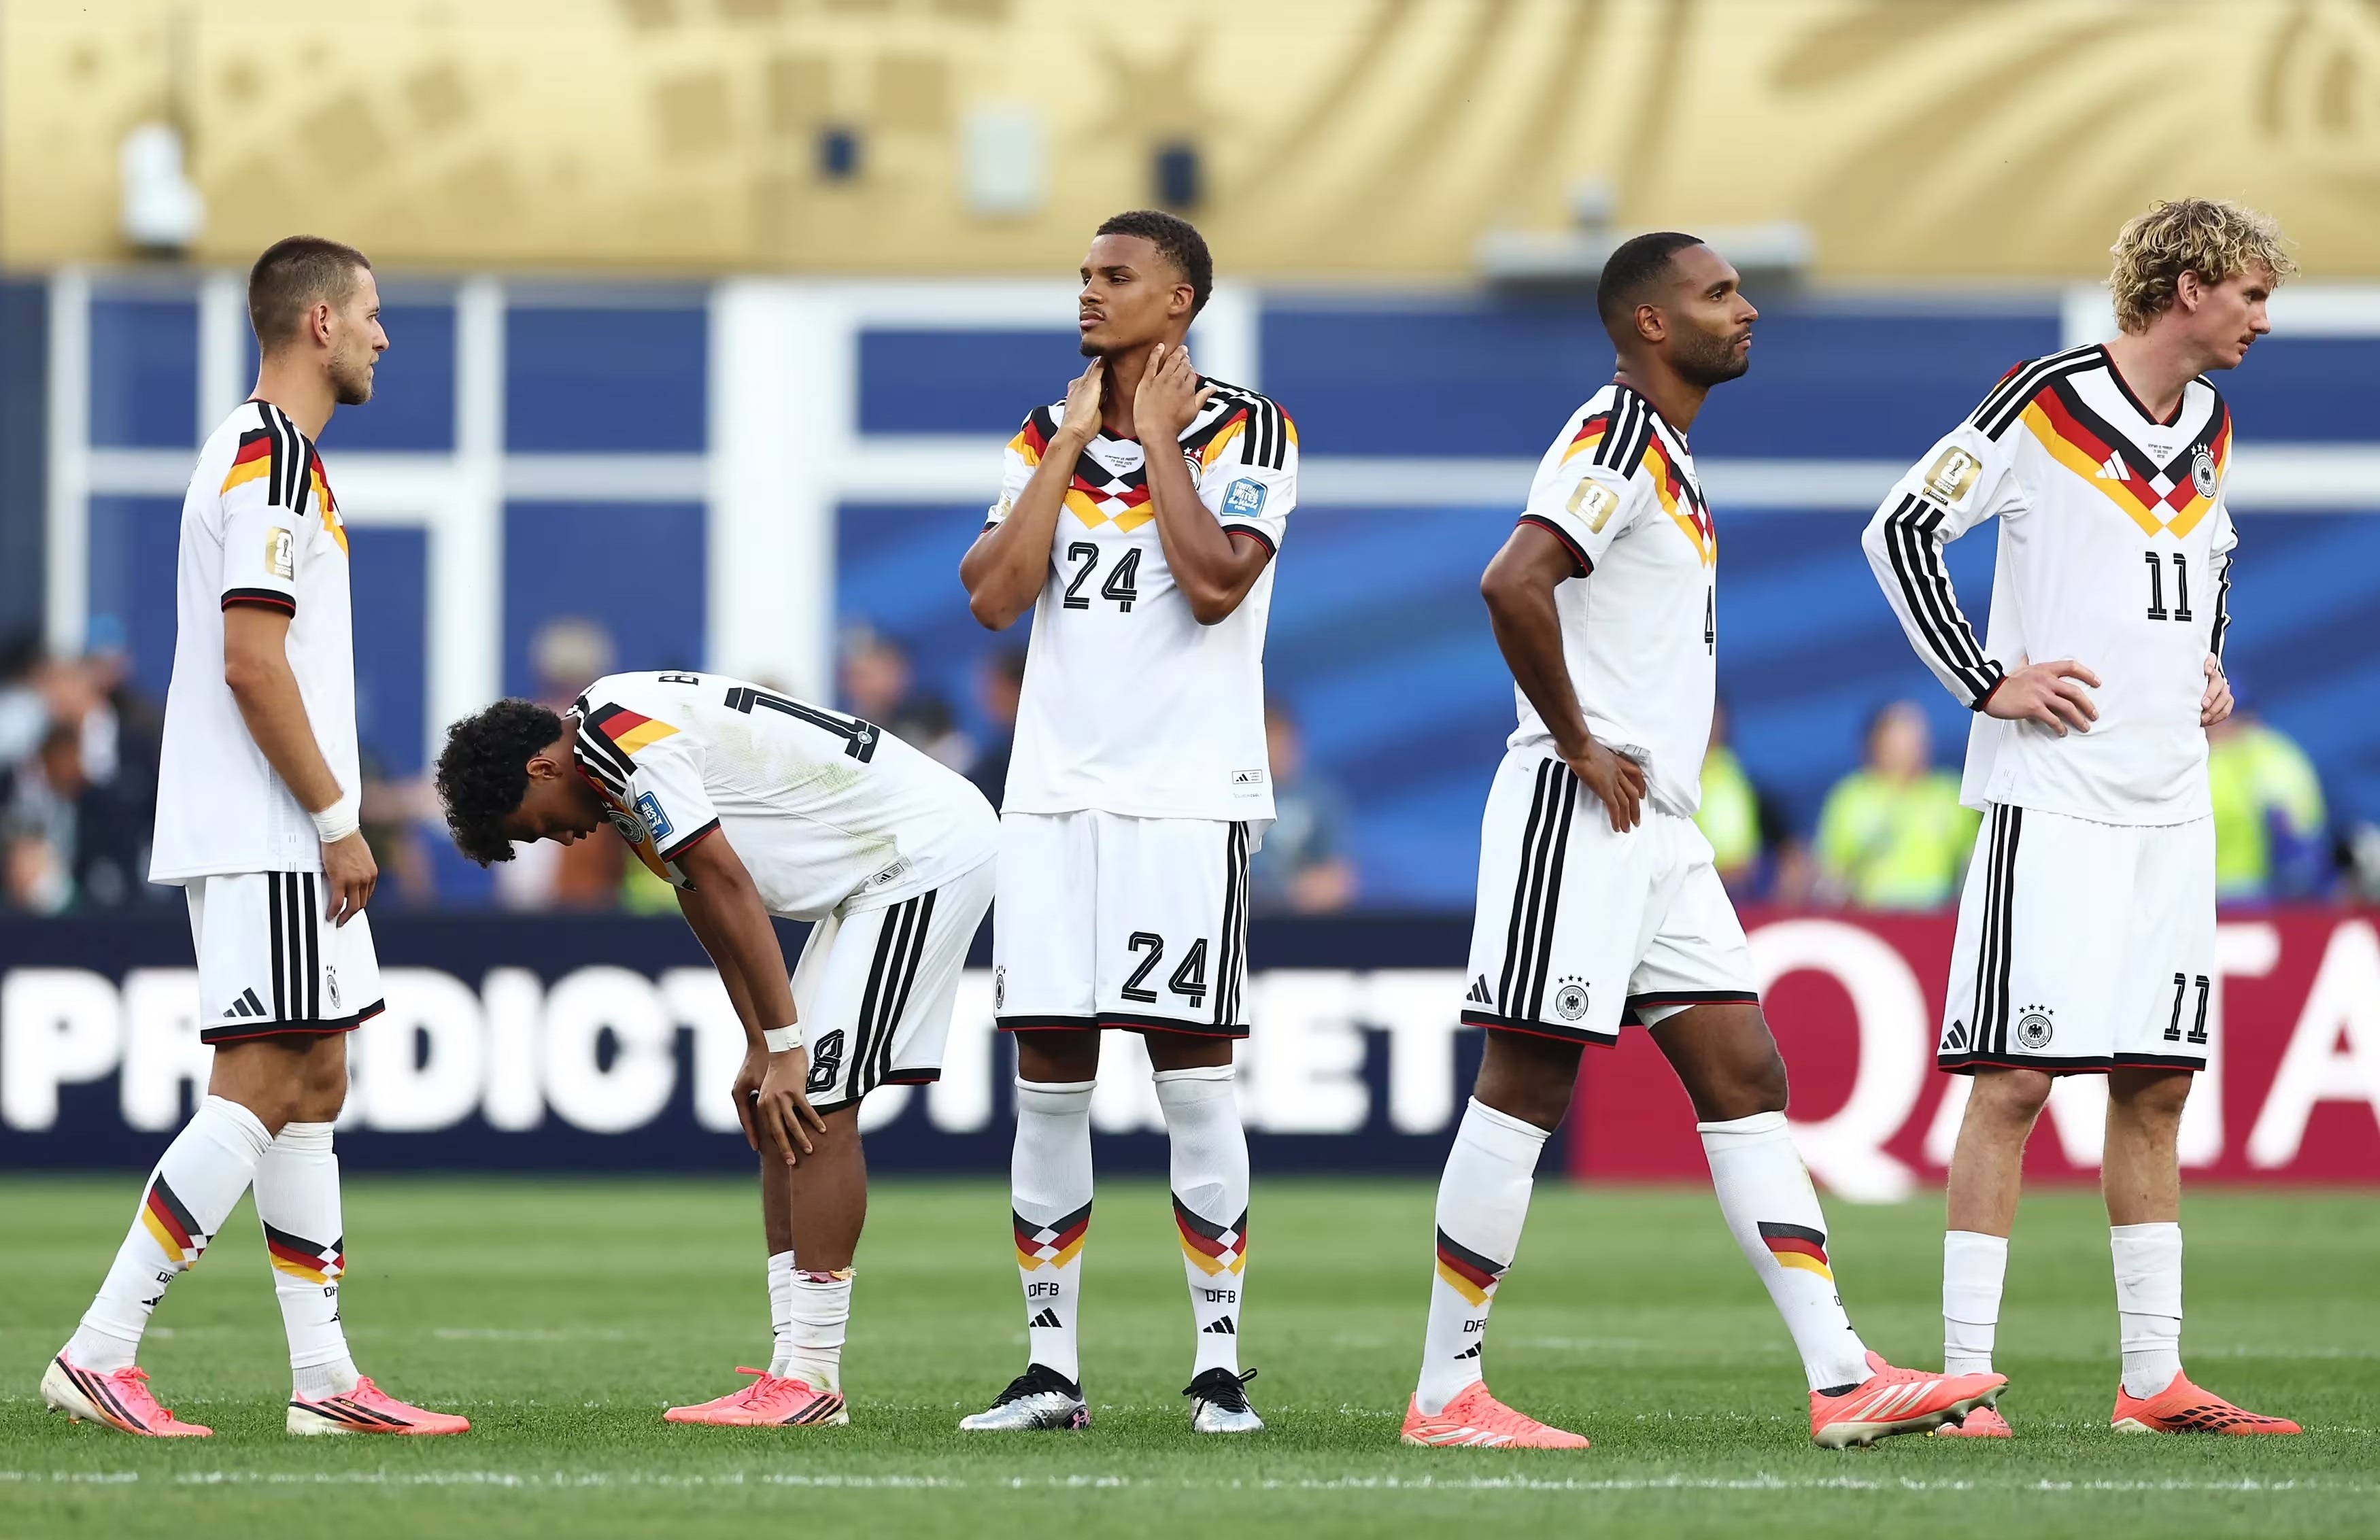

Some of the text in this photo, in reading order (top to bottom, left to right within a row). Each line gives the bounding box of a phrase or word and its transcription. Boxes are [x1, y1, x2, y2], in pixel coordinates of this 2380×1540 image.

[1233, 489, 1258, 502] UNITES
[1064, 542, 1142, 613] 24
[2145, 551, 2192, 622] 11
[1705, 585, 1714, 655] 4
[724, 687, 880, 764] 1
[1121, 931, 1208, 1008] 24
[2164, 972, 2209, 1044] 11
[0, 965, 1472, 1134] PRDICTTET
[156, 1271, 173, 1283] DF
[324, 1286, 337, 1297] DF
[1028, 1282, 1059, 1297] DFB
[1205, 1290, 1236, 1303] DFB
